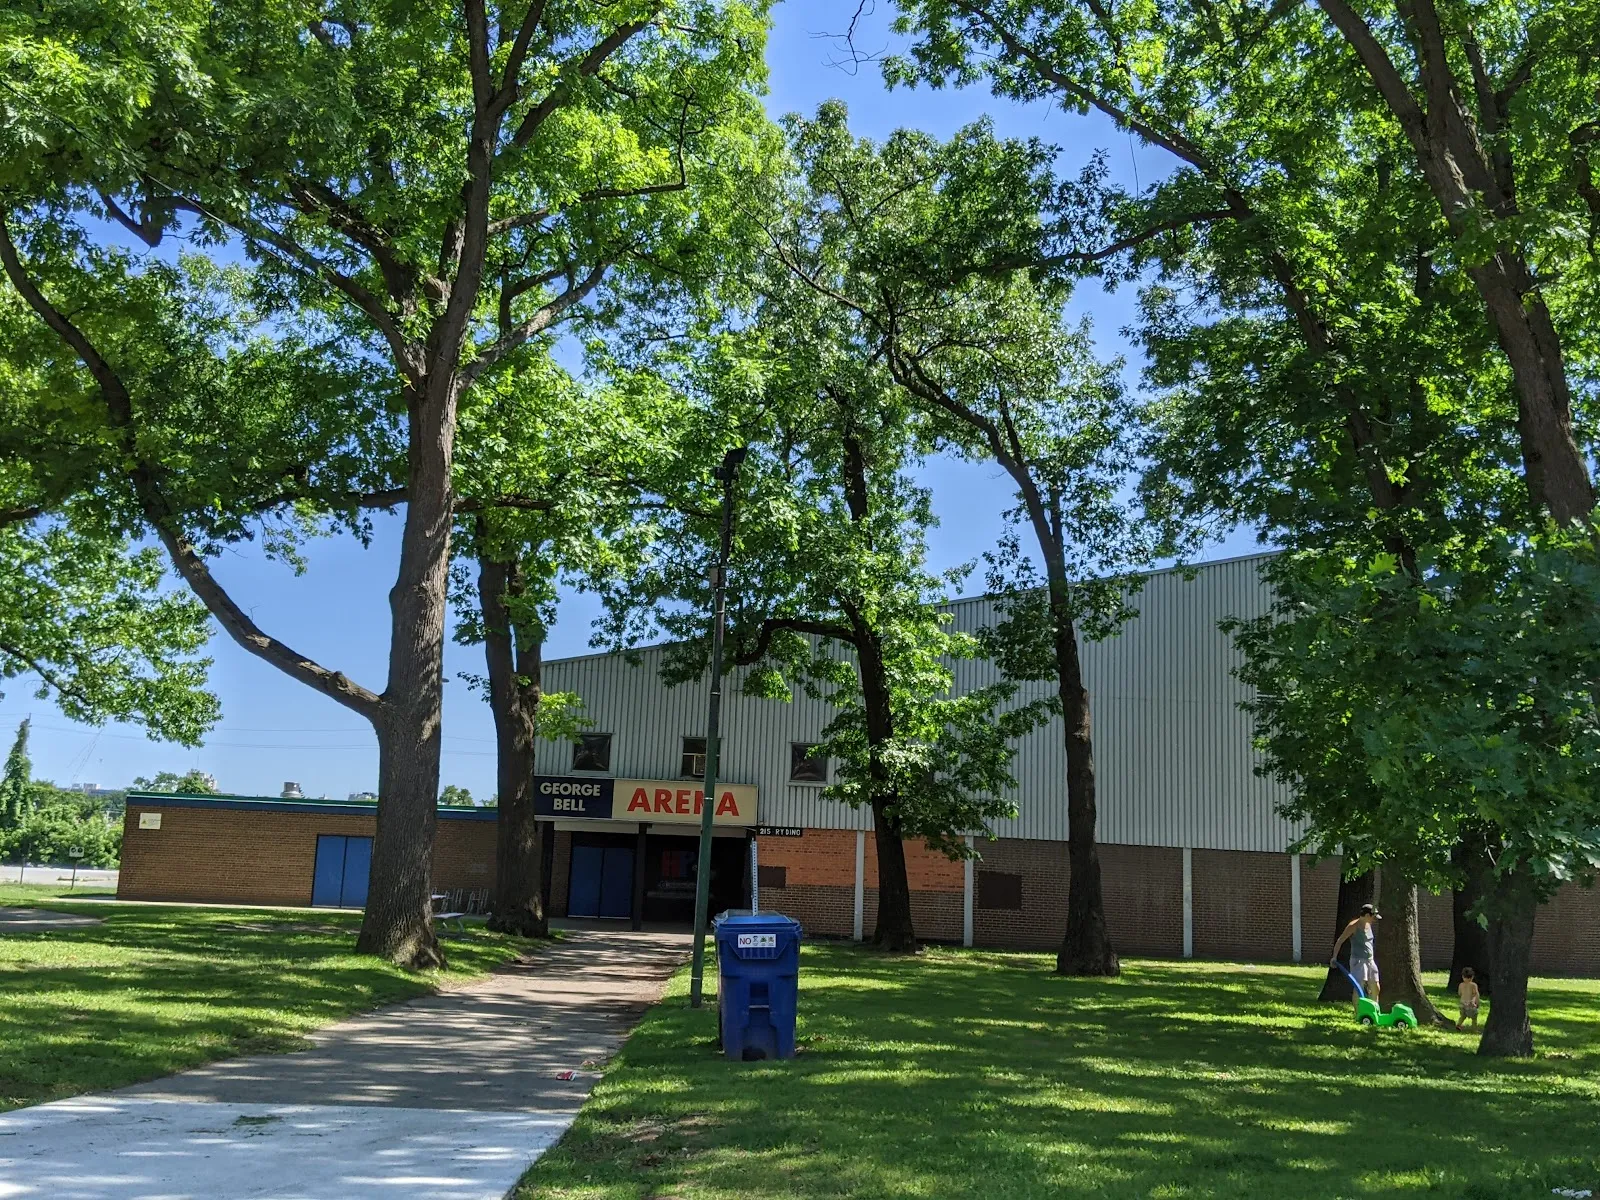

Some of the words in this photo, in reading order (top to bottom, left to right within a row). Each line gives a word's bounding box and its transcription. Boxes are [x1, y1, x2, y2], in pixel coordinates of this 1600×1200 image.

[540, 782, 601, 797] GEORGE
[553, 798, 586, 812] BELL
[739, 937, 752, 945] NO
